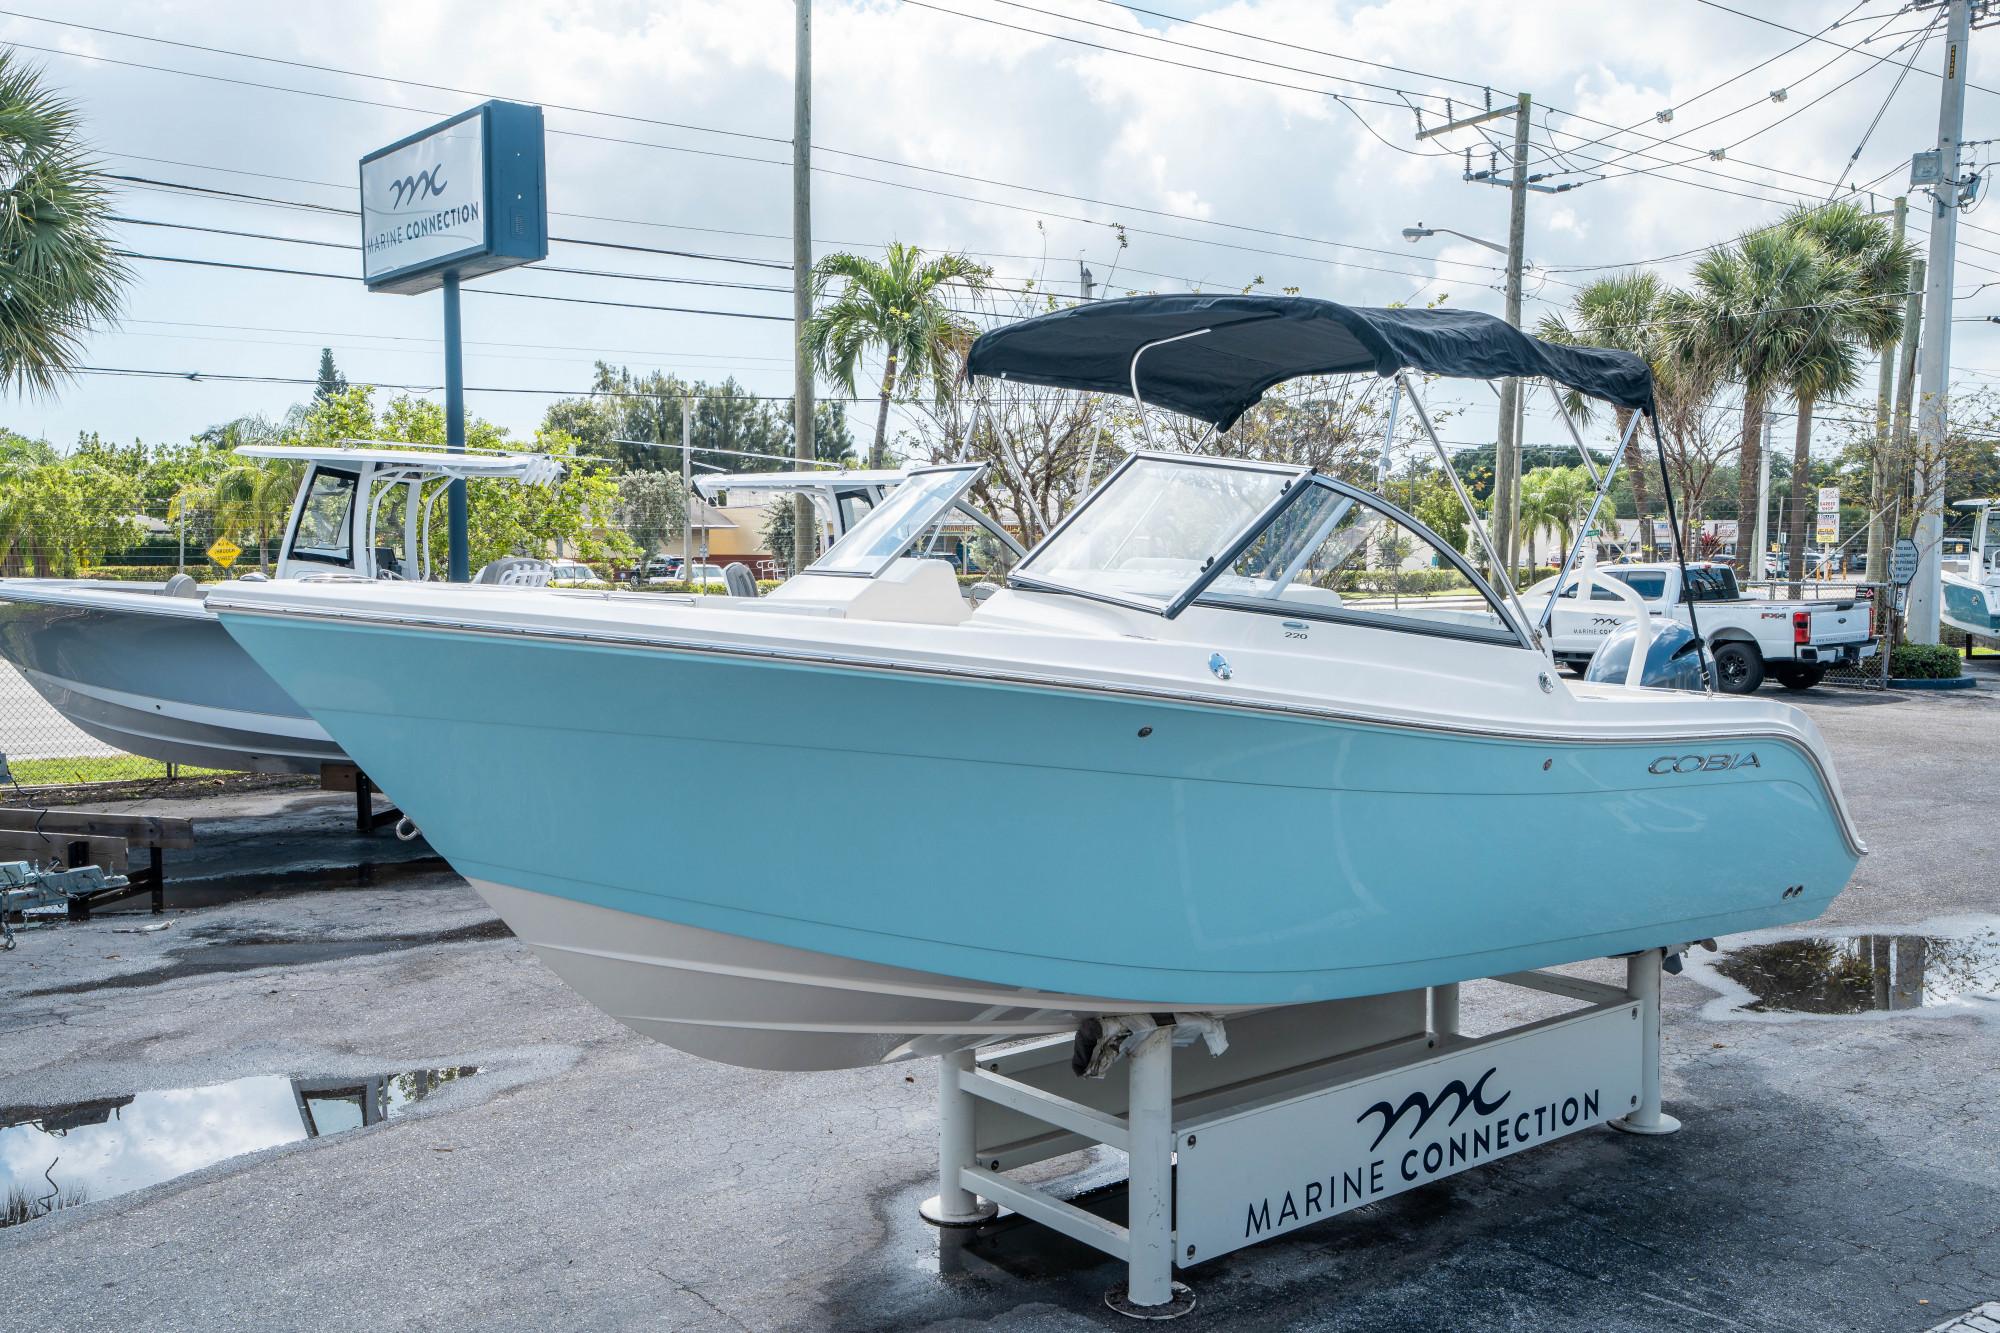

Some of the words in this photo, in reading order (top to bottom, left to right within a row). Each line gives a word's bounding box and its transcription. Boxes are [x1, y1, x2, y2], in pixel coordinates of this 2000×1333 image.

[367, 226, 402, 255] MARINE
[406, 201, 479, 240] CONNECTION
[1284, 631, 1308, 640] 220
[1648, 752, 1761, 774] COBIA
[1245, 1159, 1384, 1238] MARINE
[1400, 1089, 1599, 1181] CONNECTION
